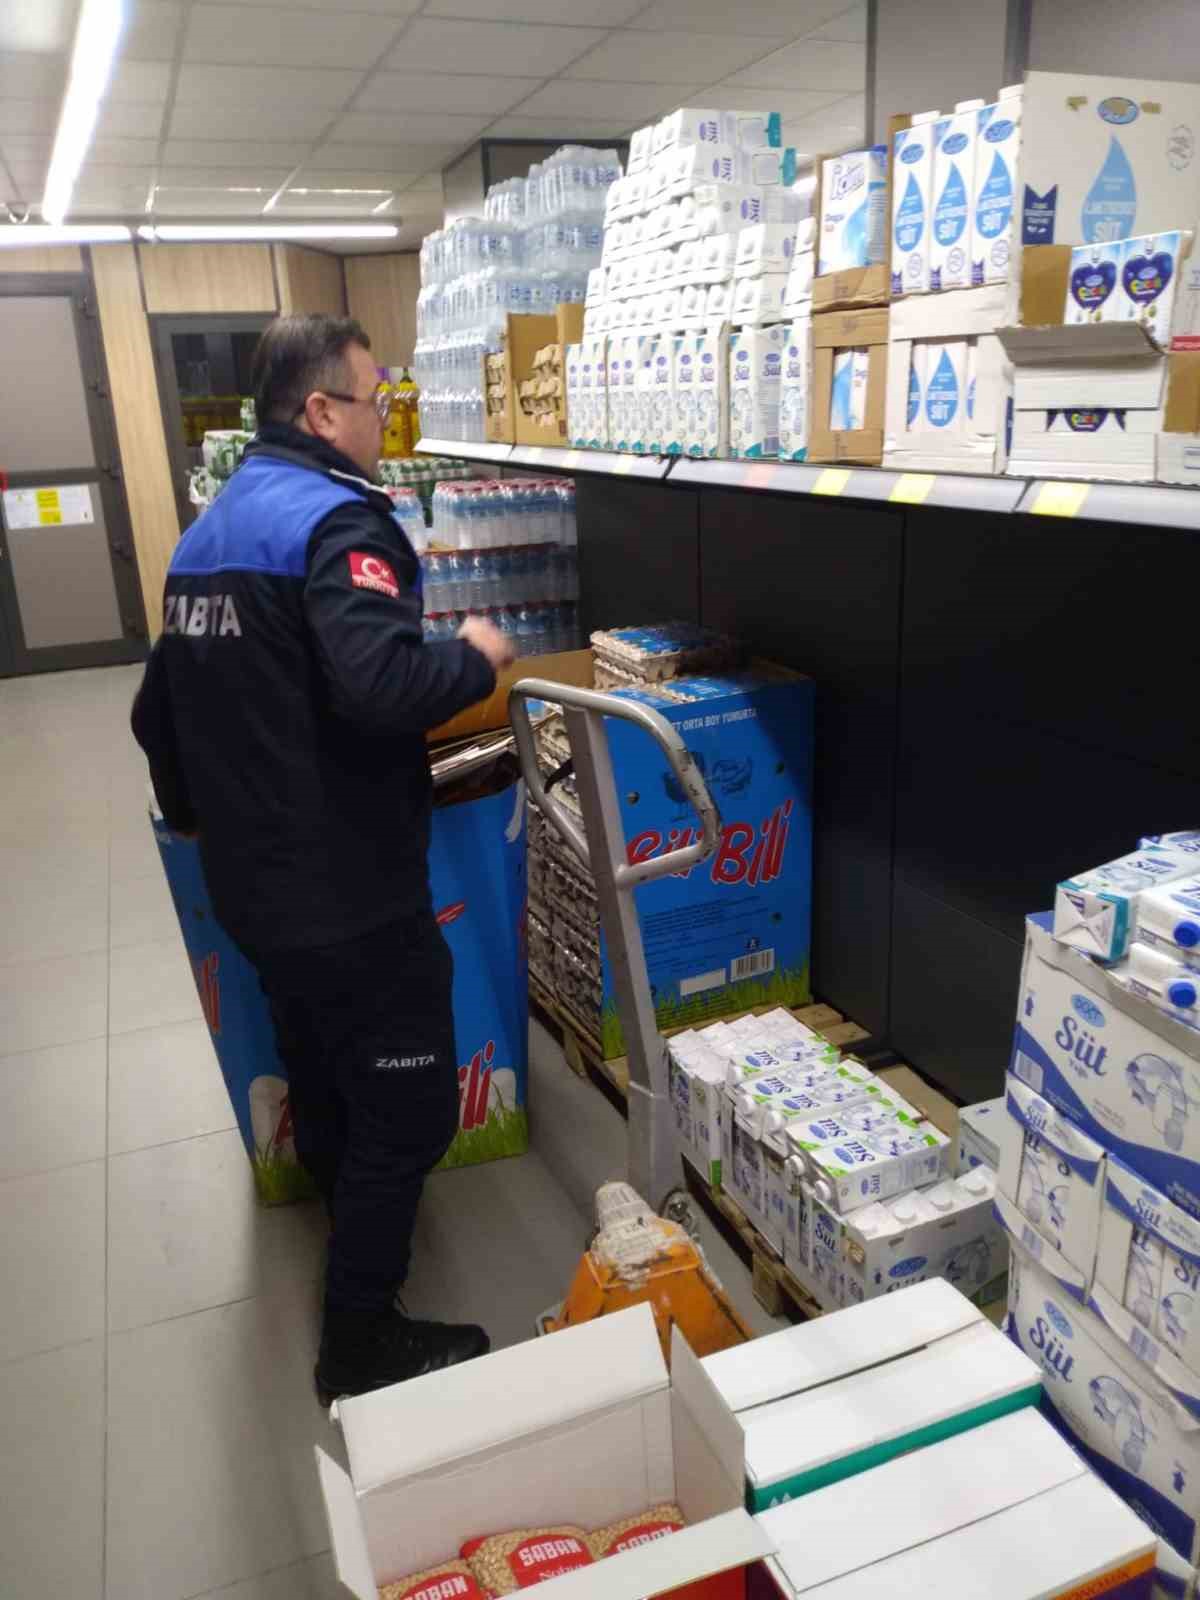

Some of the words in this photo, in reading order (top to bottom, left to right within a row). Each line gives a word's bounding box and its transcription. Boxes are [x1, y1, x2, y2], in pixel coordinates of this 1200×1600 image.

[165, 593, 242, 636] ZABTA
[682, 717, 704, 731] ORTA
[711, 799, 793, 887] Bili
[1055, 1015, 1109, 1076] Süt
[376, 1055, 435, 1068] ZABITA
[817, 1117, 848, 1138] Süt
[843, 1140, 876, 1163] Süt
[1029, 1316, 1074, 1383] Süt
[518, 1538, 583, 1567] SABAN
